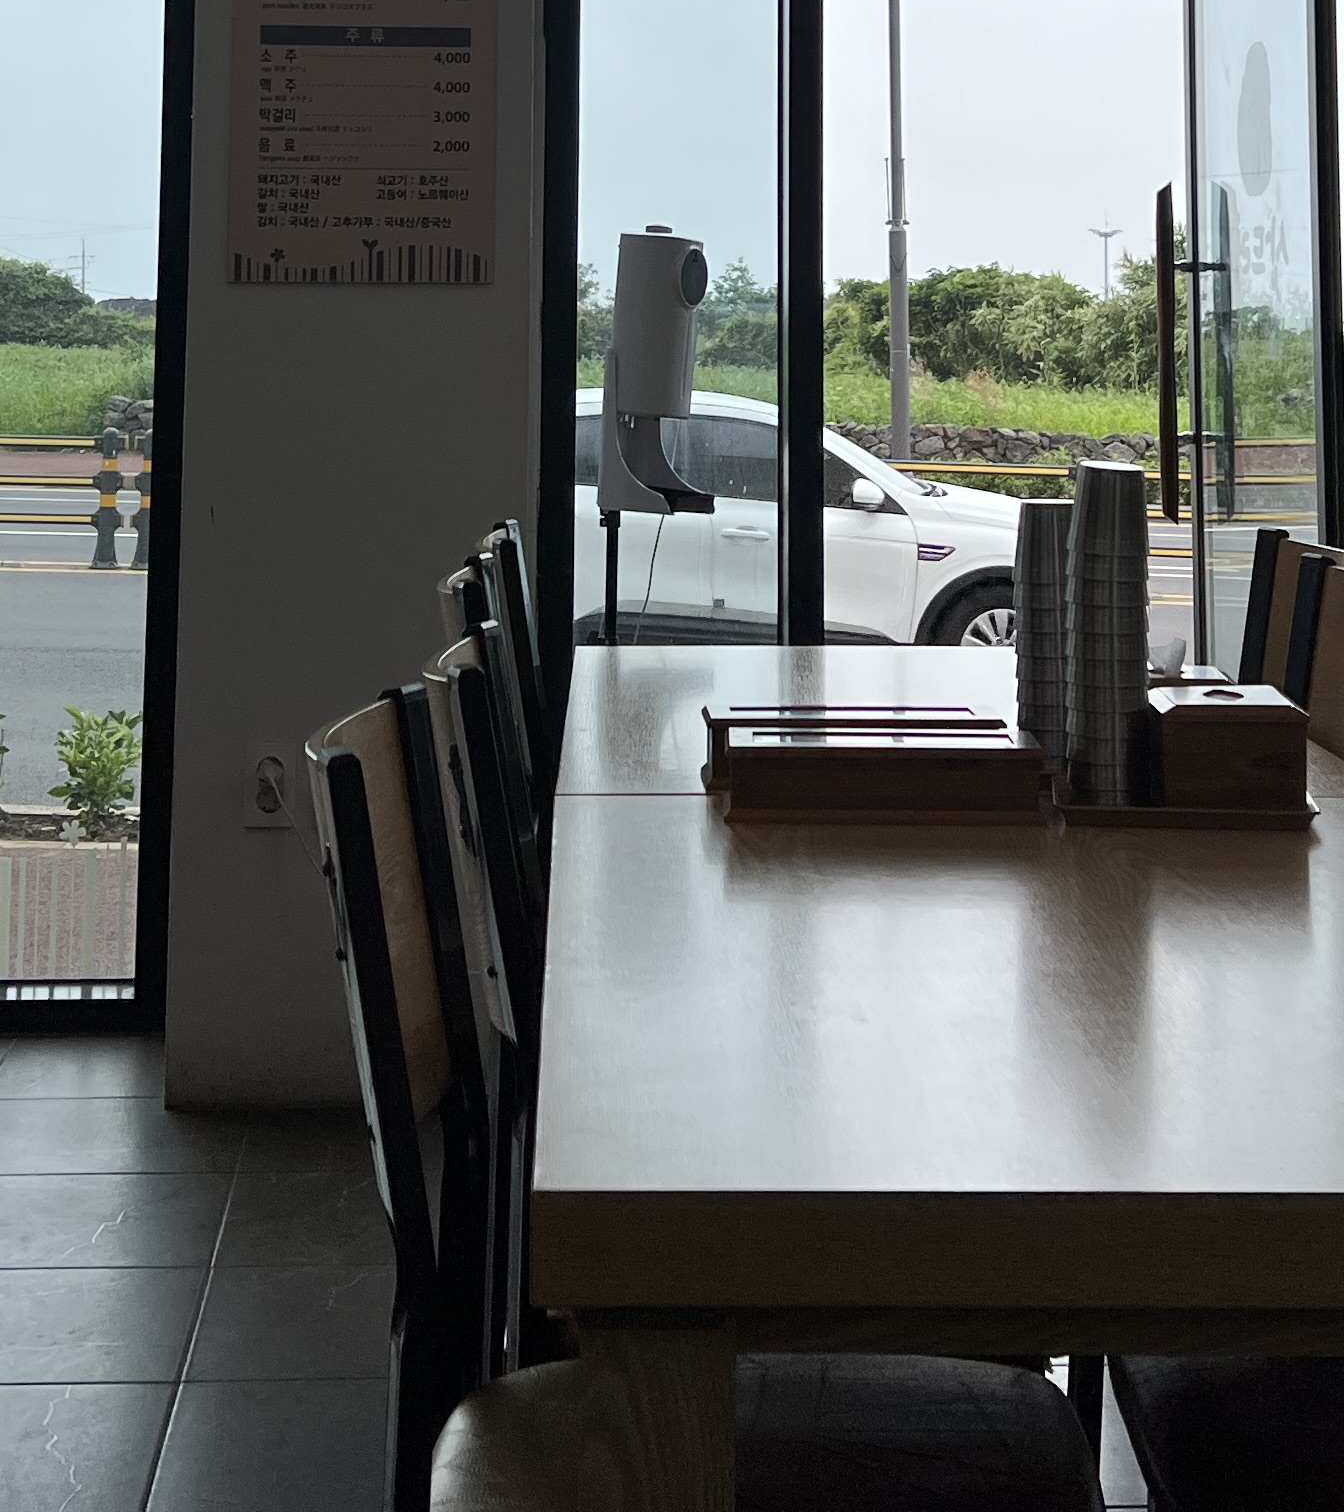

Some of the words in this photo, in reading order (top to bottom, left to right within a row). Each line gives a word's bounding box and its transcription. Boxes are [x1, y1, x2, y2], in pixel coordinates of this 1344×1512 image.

[433, 52, 471, 65] 4,000
[433, 81, 471, 95] 4,000
[259, 108, 297, 123] 막걸리
[433, 111, 471, 125] 3,000
[432, 140, 470, 154] 2,000
[309, 174, 341, 186] 국내산
[288, 188, 320, 200] 국내산
[277, 202, 310, 214] 국내산
[287, 216, 320, 228] 국내산
